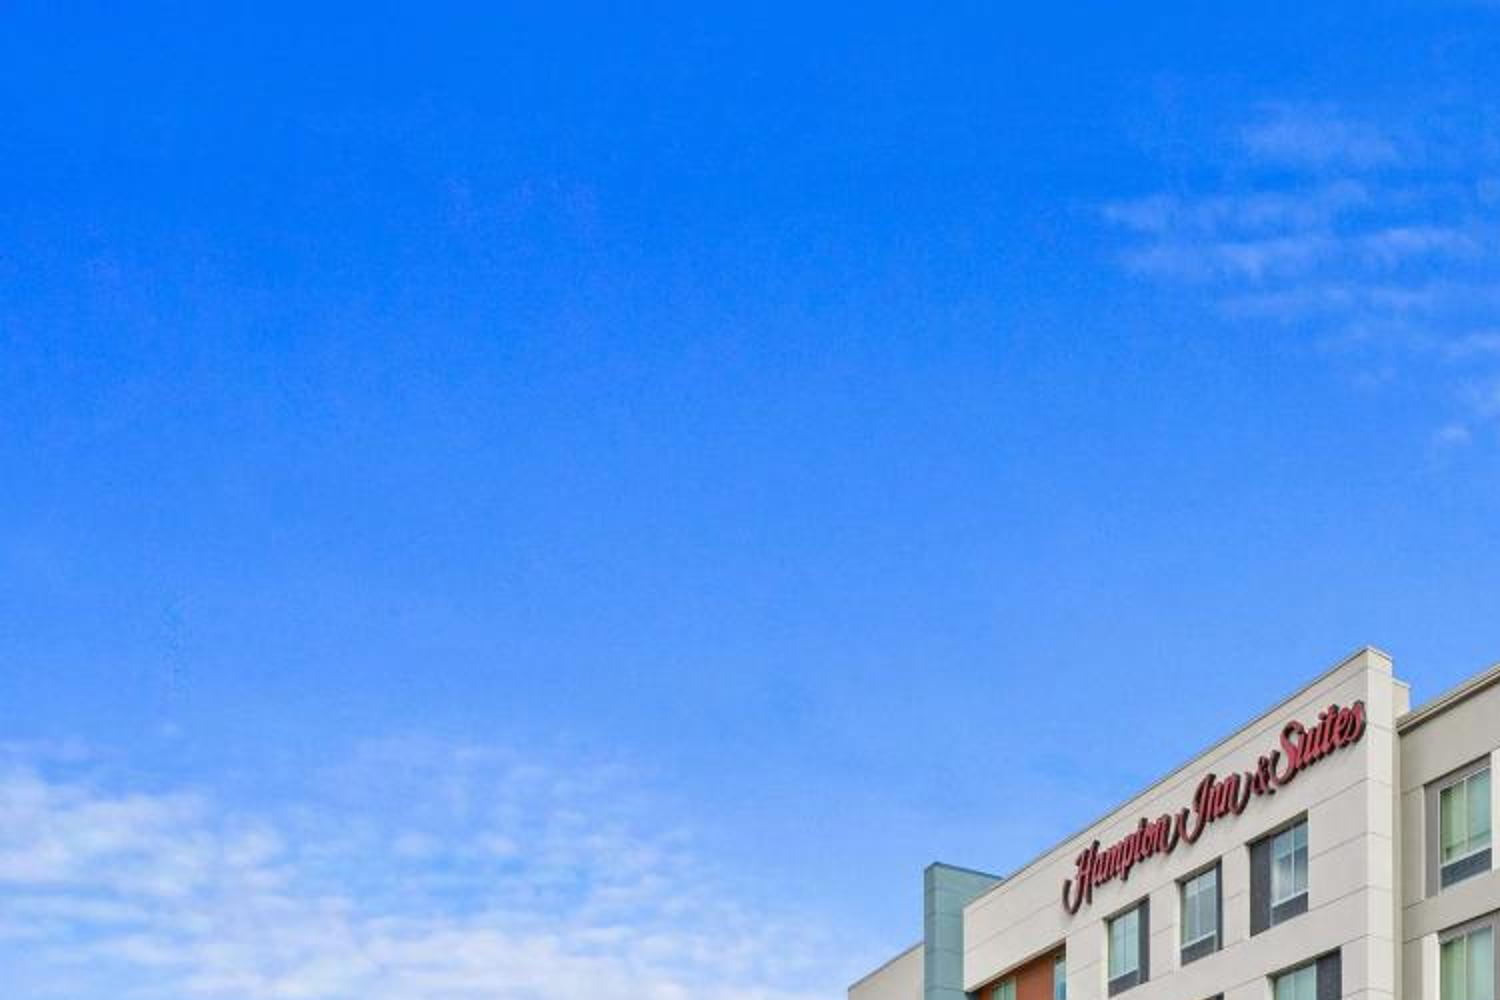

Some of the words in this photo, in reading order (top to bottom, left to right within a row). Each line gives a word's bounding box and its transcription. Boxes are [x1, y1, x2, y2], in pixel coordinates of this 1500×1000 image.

[1062, 812, 1181, 914] Hampton
[1180, 773, 1252, 844] Inn
[1252, 756, 1276, 796] &
[1270, 700, 1366, 785] Suites
